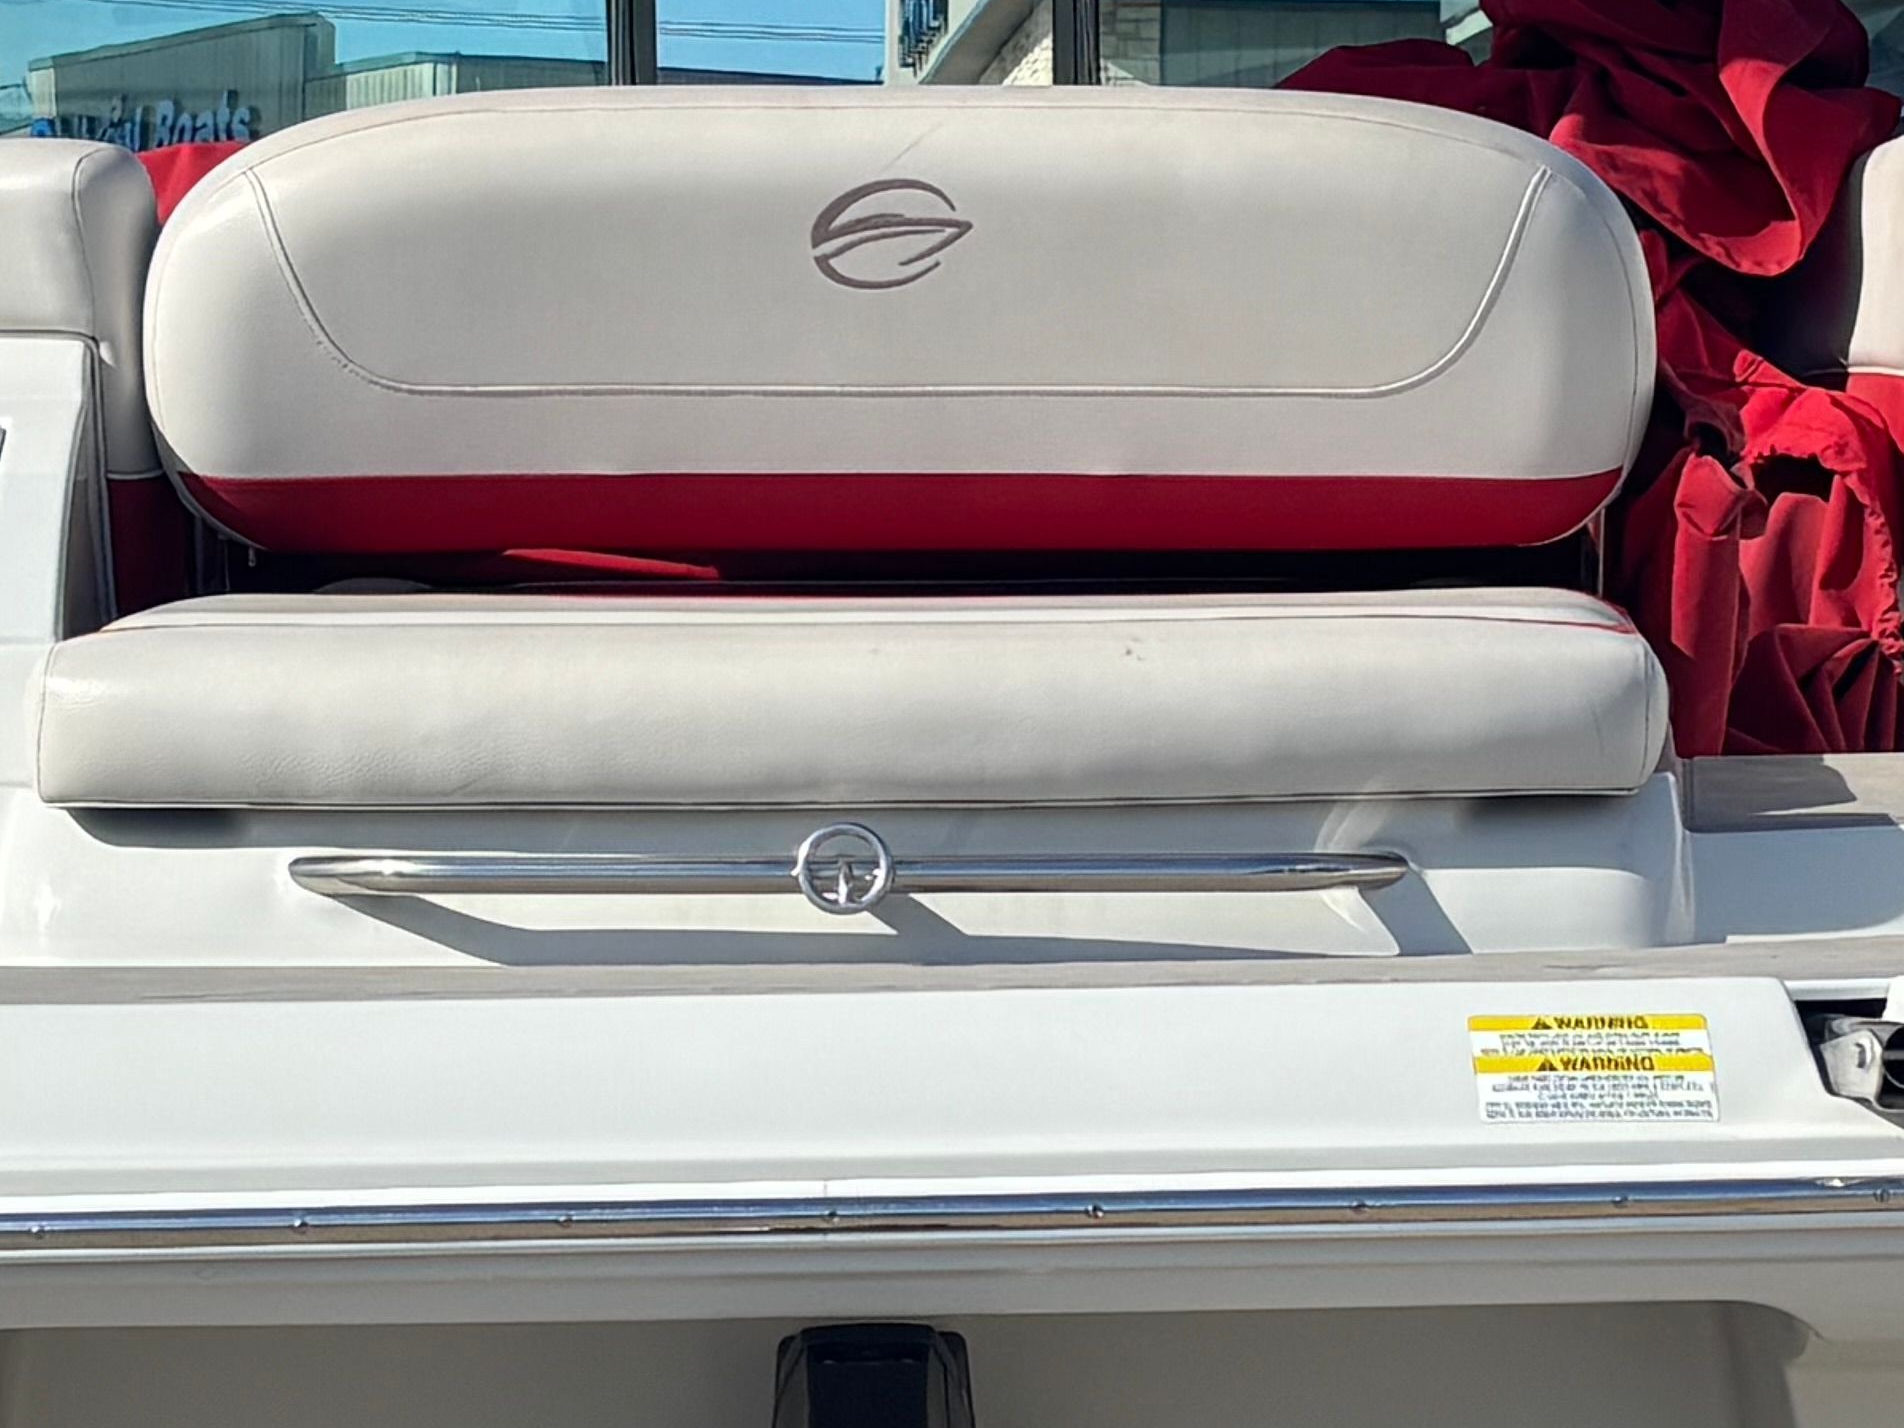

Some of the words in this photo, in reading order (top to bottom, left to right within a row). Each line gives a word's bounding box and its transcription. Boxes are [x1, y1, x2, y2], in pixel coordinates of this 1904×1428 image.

[156, 91, 250, 147] Boats
[1553, 1015, 1649, 1031] WARNING
[1560, 1055, 1655, 1072] WARNING
